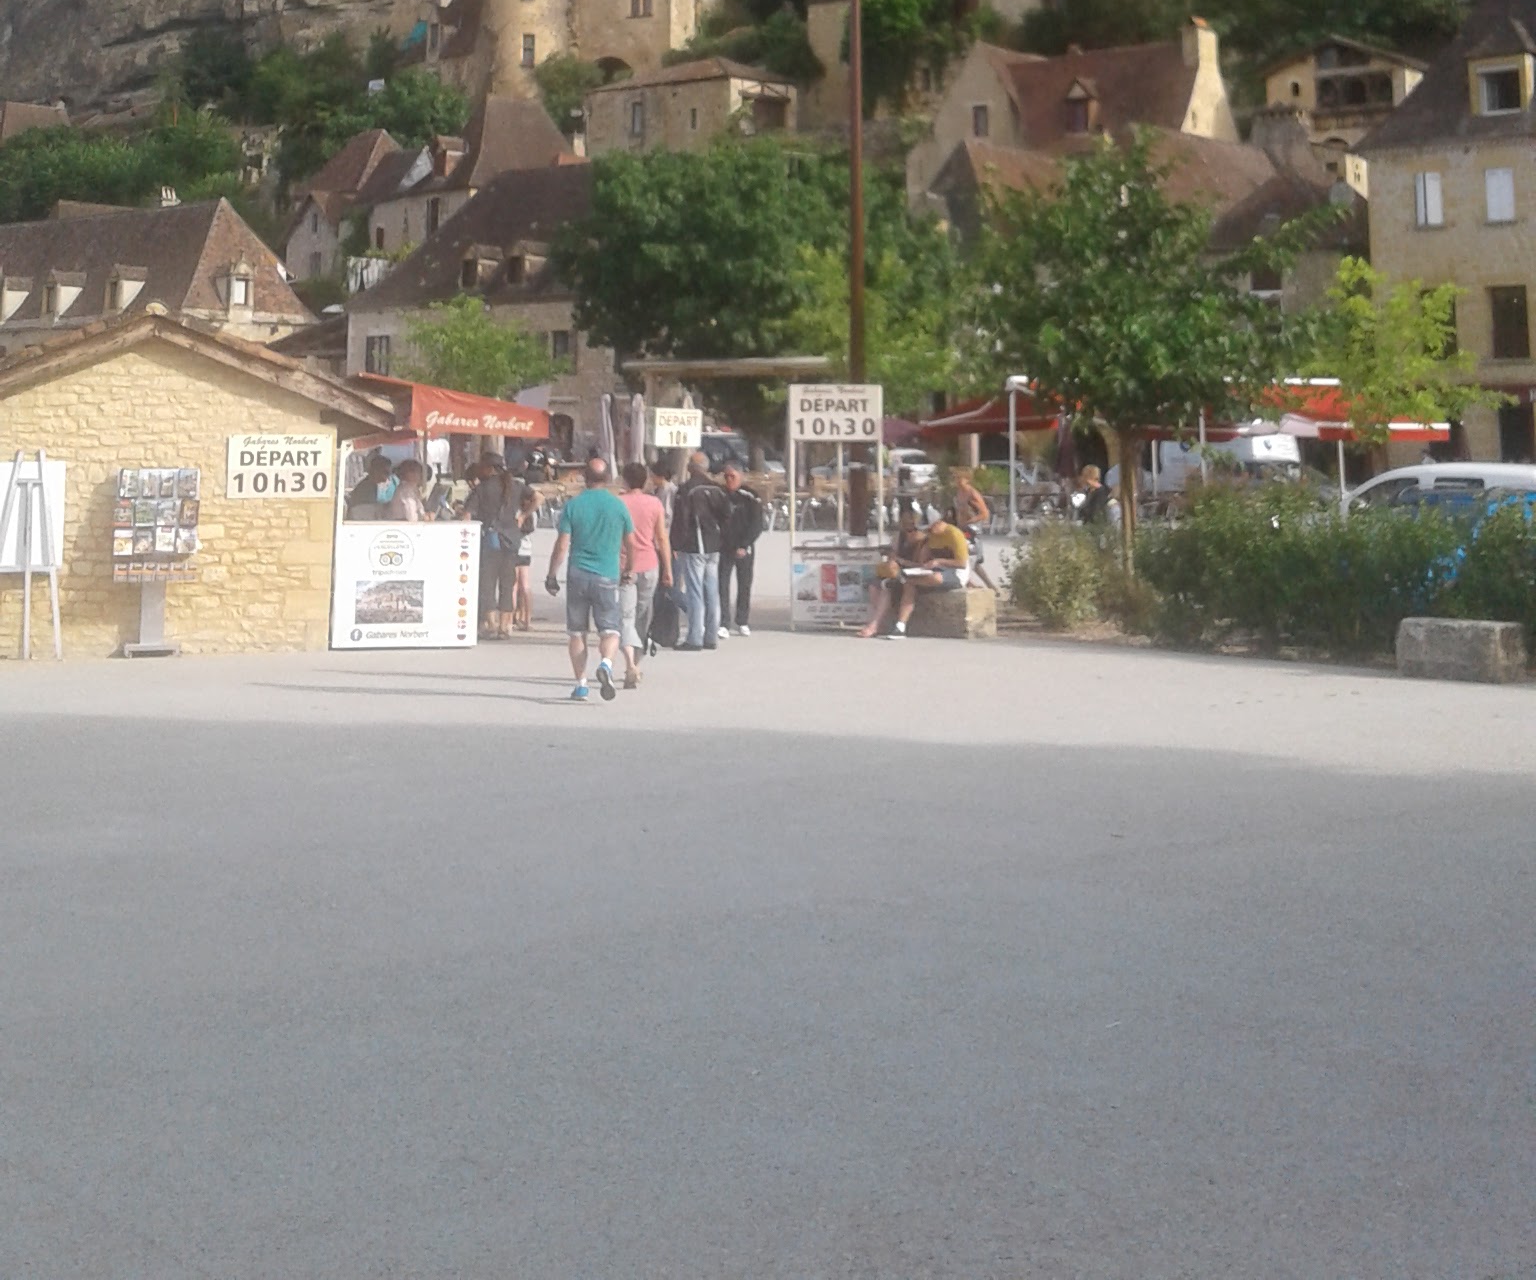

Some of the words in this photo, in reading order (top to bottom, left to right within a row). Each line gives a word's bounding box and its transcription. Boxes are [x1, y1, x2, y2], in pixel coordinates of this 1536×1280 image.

[425, 410, 479, 428] Gabares
[482, 414, 534, 431] Norbert
[795, 417, 875, 435] 10h30
[243, 436, 279, 447] Gabares
[240, 445, 322, 466] DÉPART
[233, 472, 327, 493] 10h30
